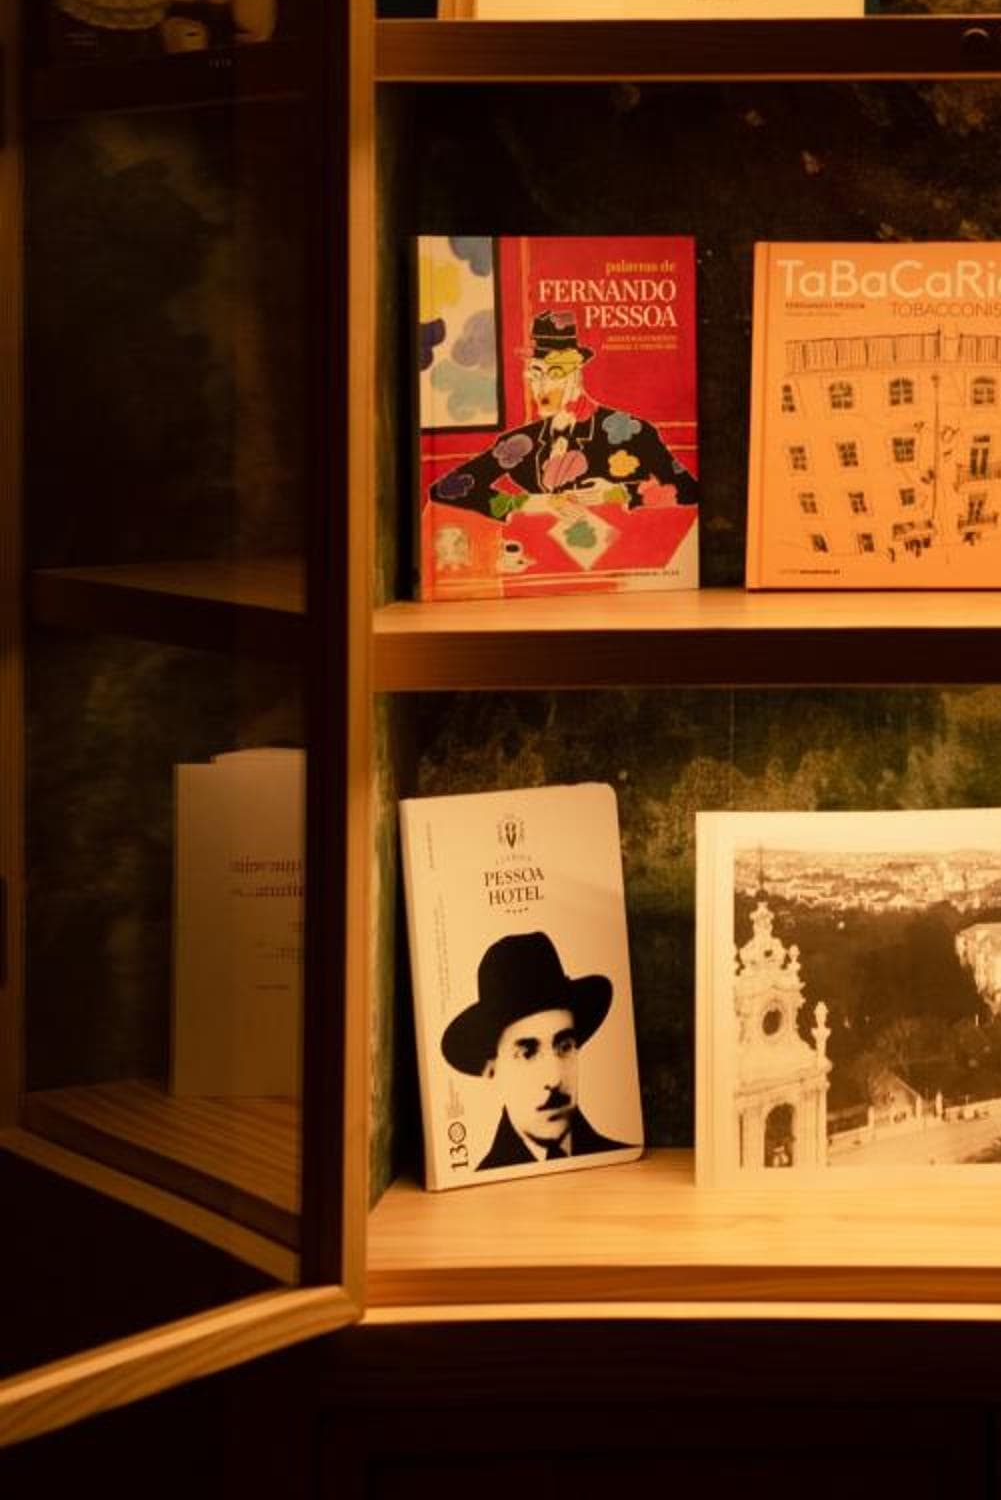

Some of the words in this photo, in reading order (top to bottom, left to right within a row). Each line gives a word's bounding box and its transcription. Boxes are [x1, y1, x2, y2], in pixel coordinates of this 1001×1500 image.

[538, 278, 677, 303] FERNANDO
[584, 304, 678, 329] PESSOA
[483, 867, 545, 888] PESSOA
[488, 885, 545, 906] HOTEL
